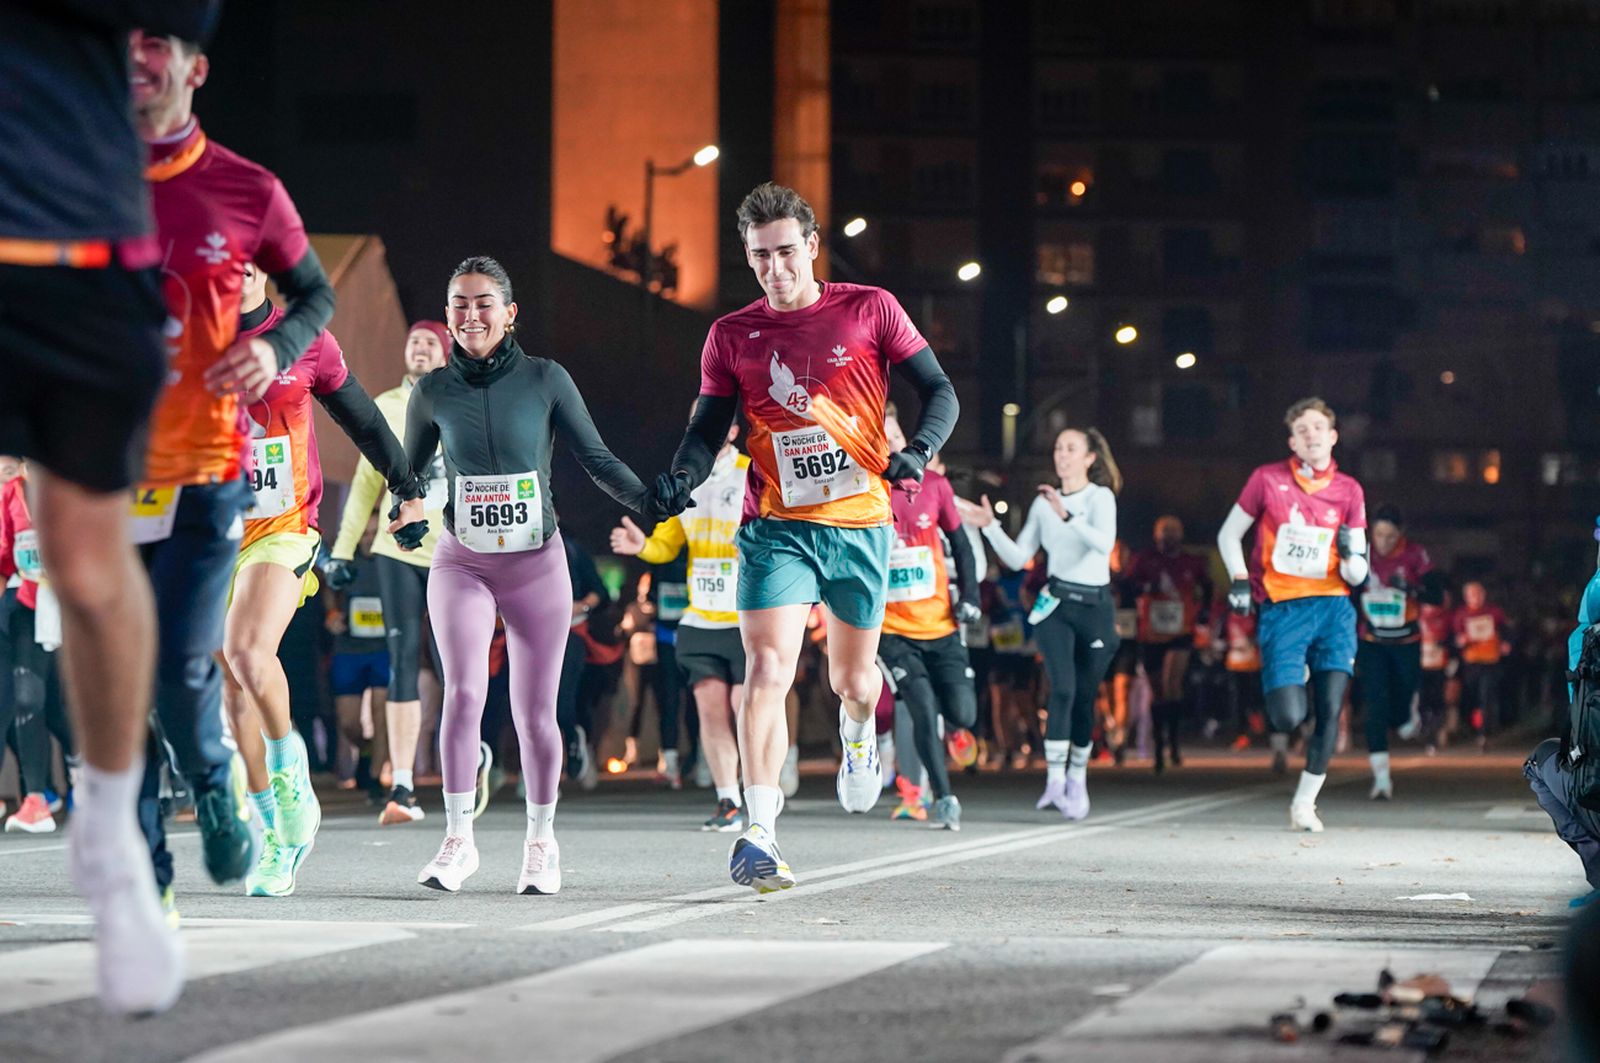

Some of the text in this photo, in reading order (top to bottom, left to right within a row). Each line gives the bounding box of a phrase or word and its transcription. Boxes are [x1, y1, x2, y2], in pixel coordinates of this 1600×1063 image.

[786, 392, 808, 413] 43
[792, 436, 815, 446] NOCHE
[784, 442, 829, 457] SAN ANTÓN
[792, 448, 850, 479] 5692
[474, 484, 498, 492] NOCHE
[500, 484, 510, 492] DE
[465, 494, 482, 503] SAN
[483, 492, 510, 502] ANTÓN
[470, 502, 528, 527] 5693
[1287, 543, 1320, 560] 2579
[891, 567, 924, 584] 8310
[696, 577, 725, 592] 1759
